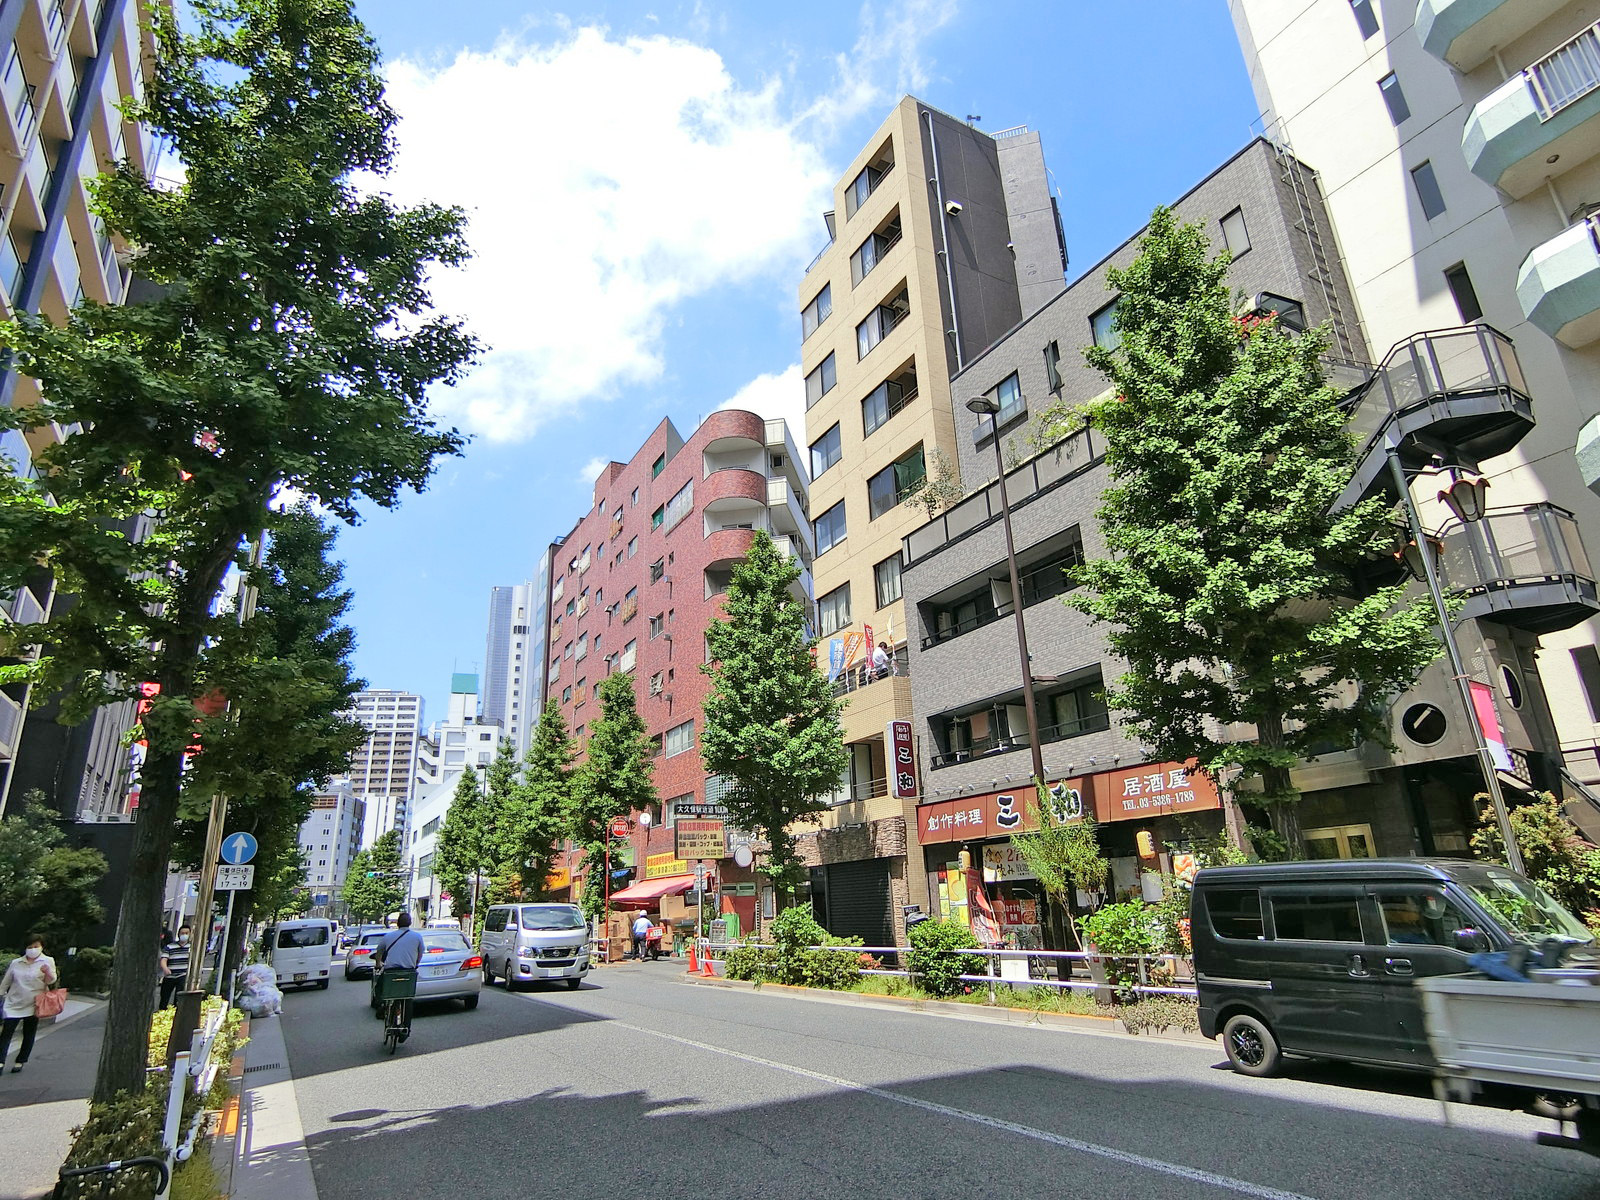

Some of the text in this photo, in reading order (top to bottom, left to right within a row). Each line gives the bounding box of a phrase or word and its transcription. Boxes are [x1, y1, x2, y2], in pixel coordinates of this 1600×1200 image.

[898, 746, 914, 791] 三和
[1122, 768, 1191, 797] 居酒屋
[927, 808, 983, 831] 創作料理
